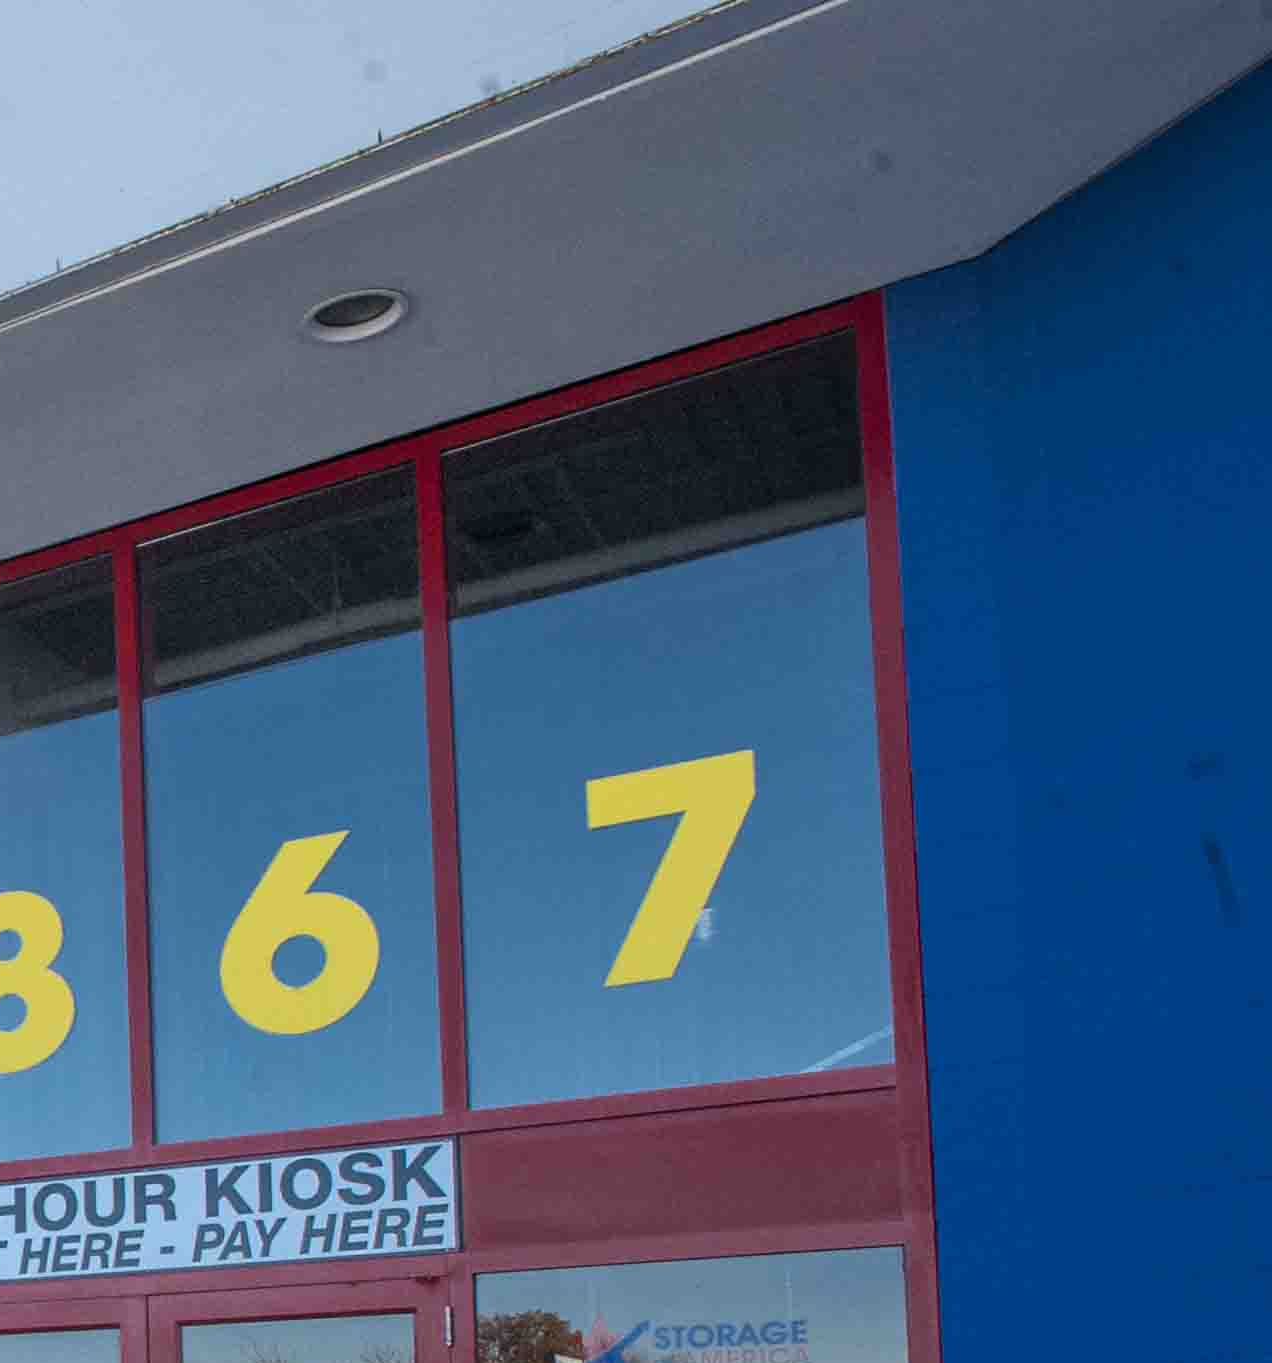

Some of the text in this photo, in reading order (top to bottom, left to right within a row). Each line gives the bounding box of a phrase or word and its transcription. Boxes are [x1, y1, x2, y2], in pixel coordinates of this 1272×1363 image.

[205, 1144, 447, 1218] KIOSK
[19, 1230, 144, 1275] HERE
[192, 1217, 287, 1263] PAY
[300, 1204, 449, 1255] HERE
[655, 1319, 809, 1350] STORAGE
